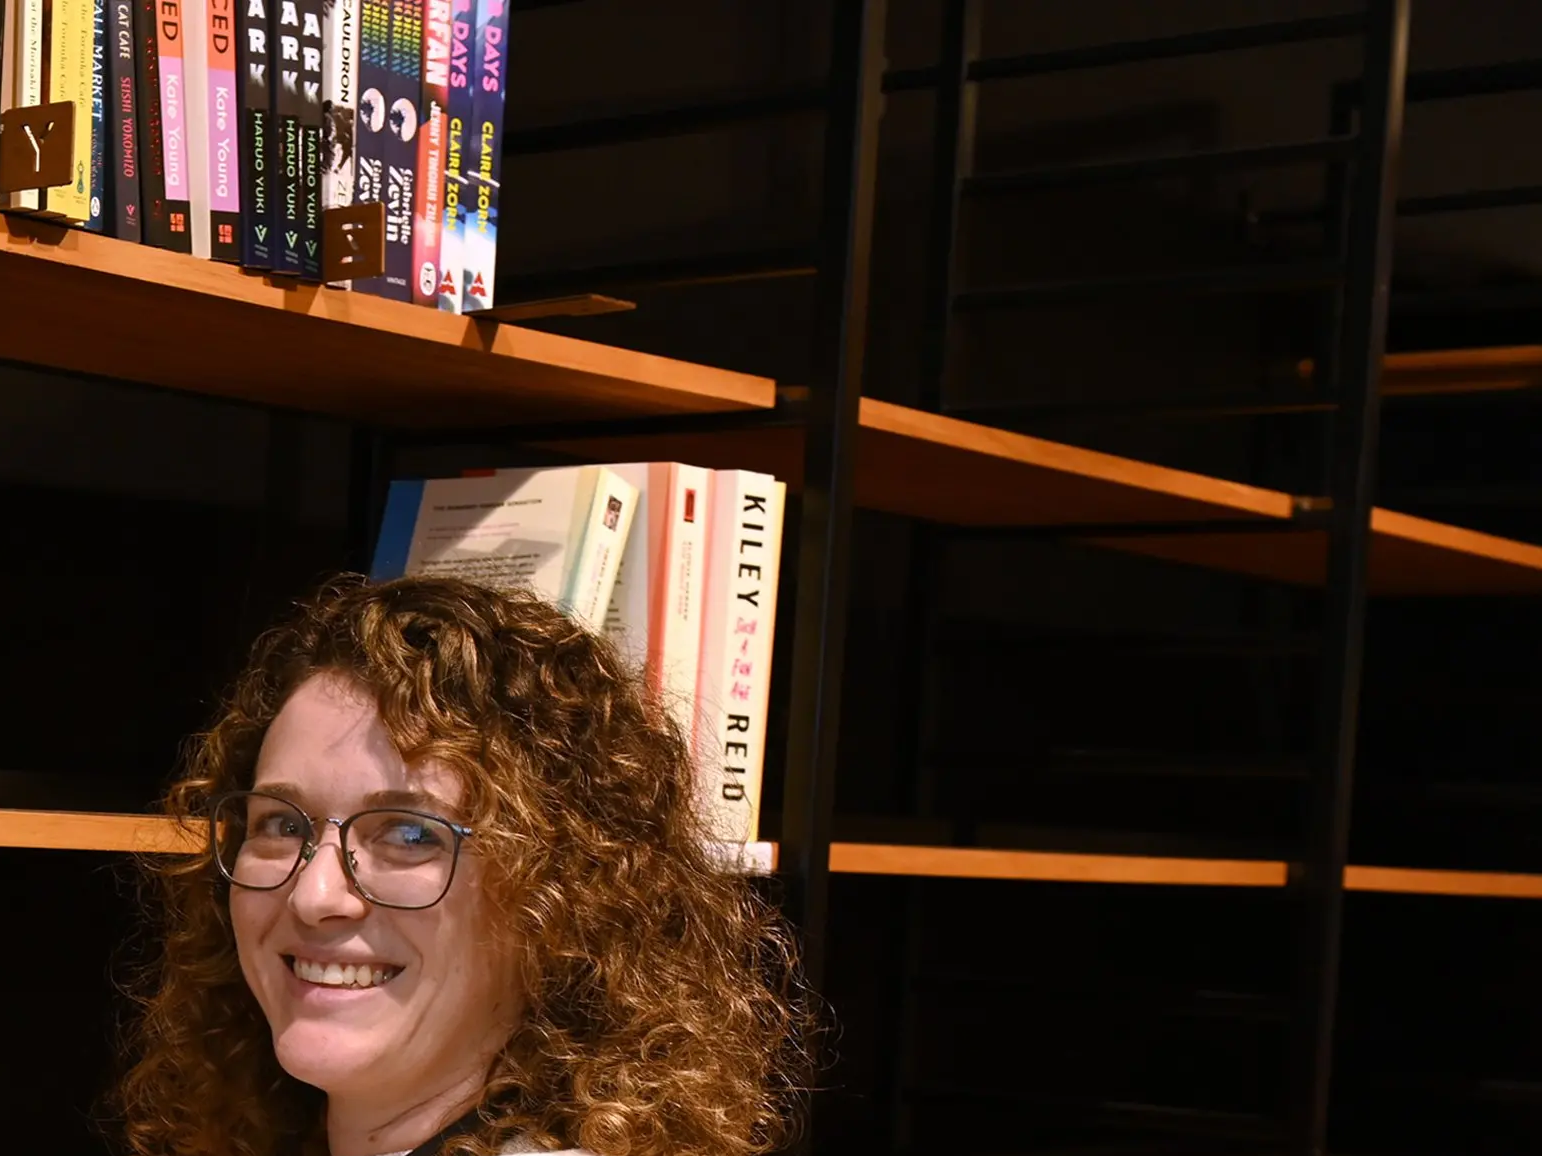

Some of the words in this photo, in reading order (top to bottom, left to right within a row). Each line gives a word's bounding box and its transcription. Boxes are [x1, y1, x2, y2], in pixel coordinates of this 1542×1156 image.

[118, 4, 129, 27] CAT
[165, 74, 180, 120] Kate
[122, 117, 135, 177] YOKOMIZO
[166, 127, 183, 186] Young
[254, 112, 264, 171] HARUO
[448, 118, 462, 178] CLAIRE
[255, 176, 264, 214] YUKI
[386, 165, 403, 242] Zevin
[446, 182, 459, 231] ZORN
[736, 494, 767, 608] KILEY
[722, 714, 750, 802] REID
